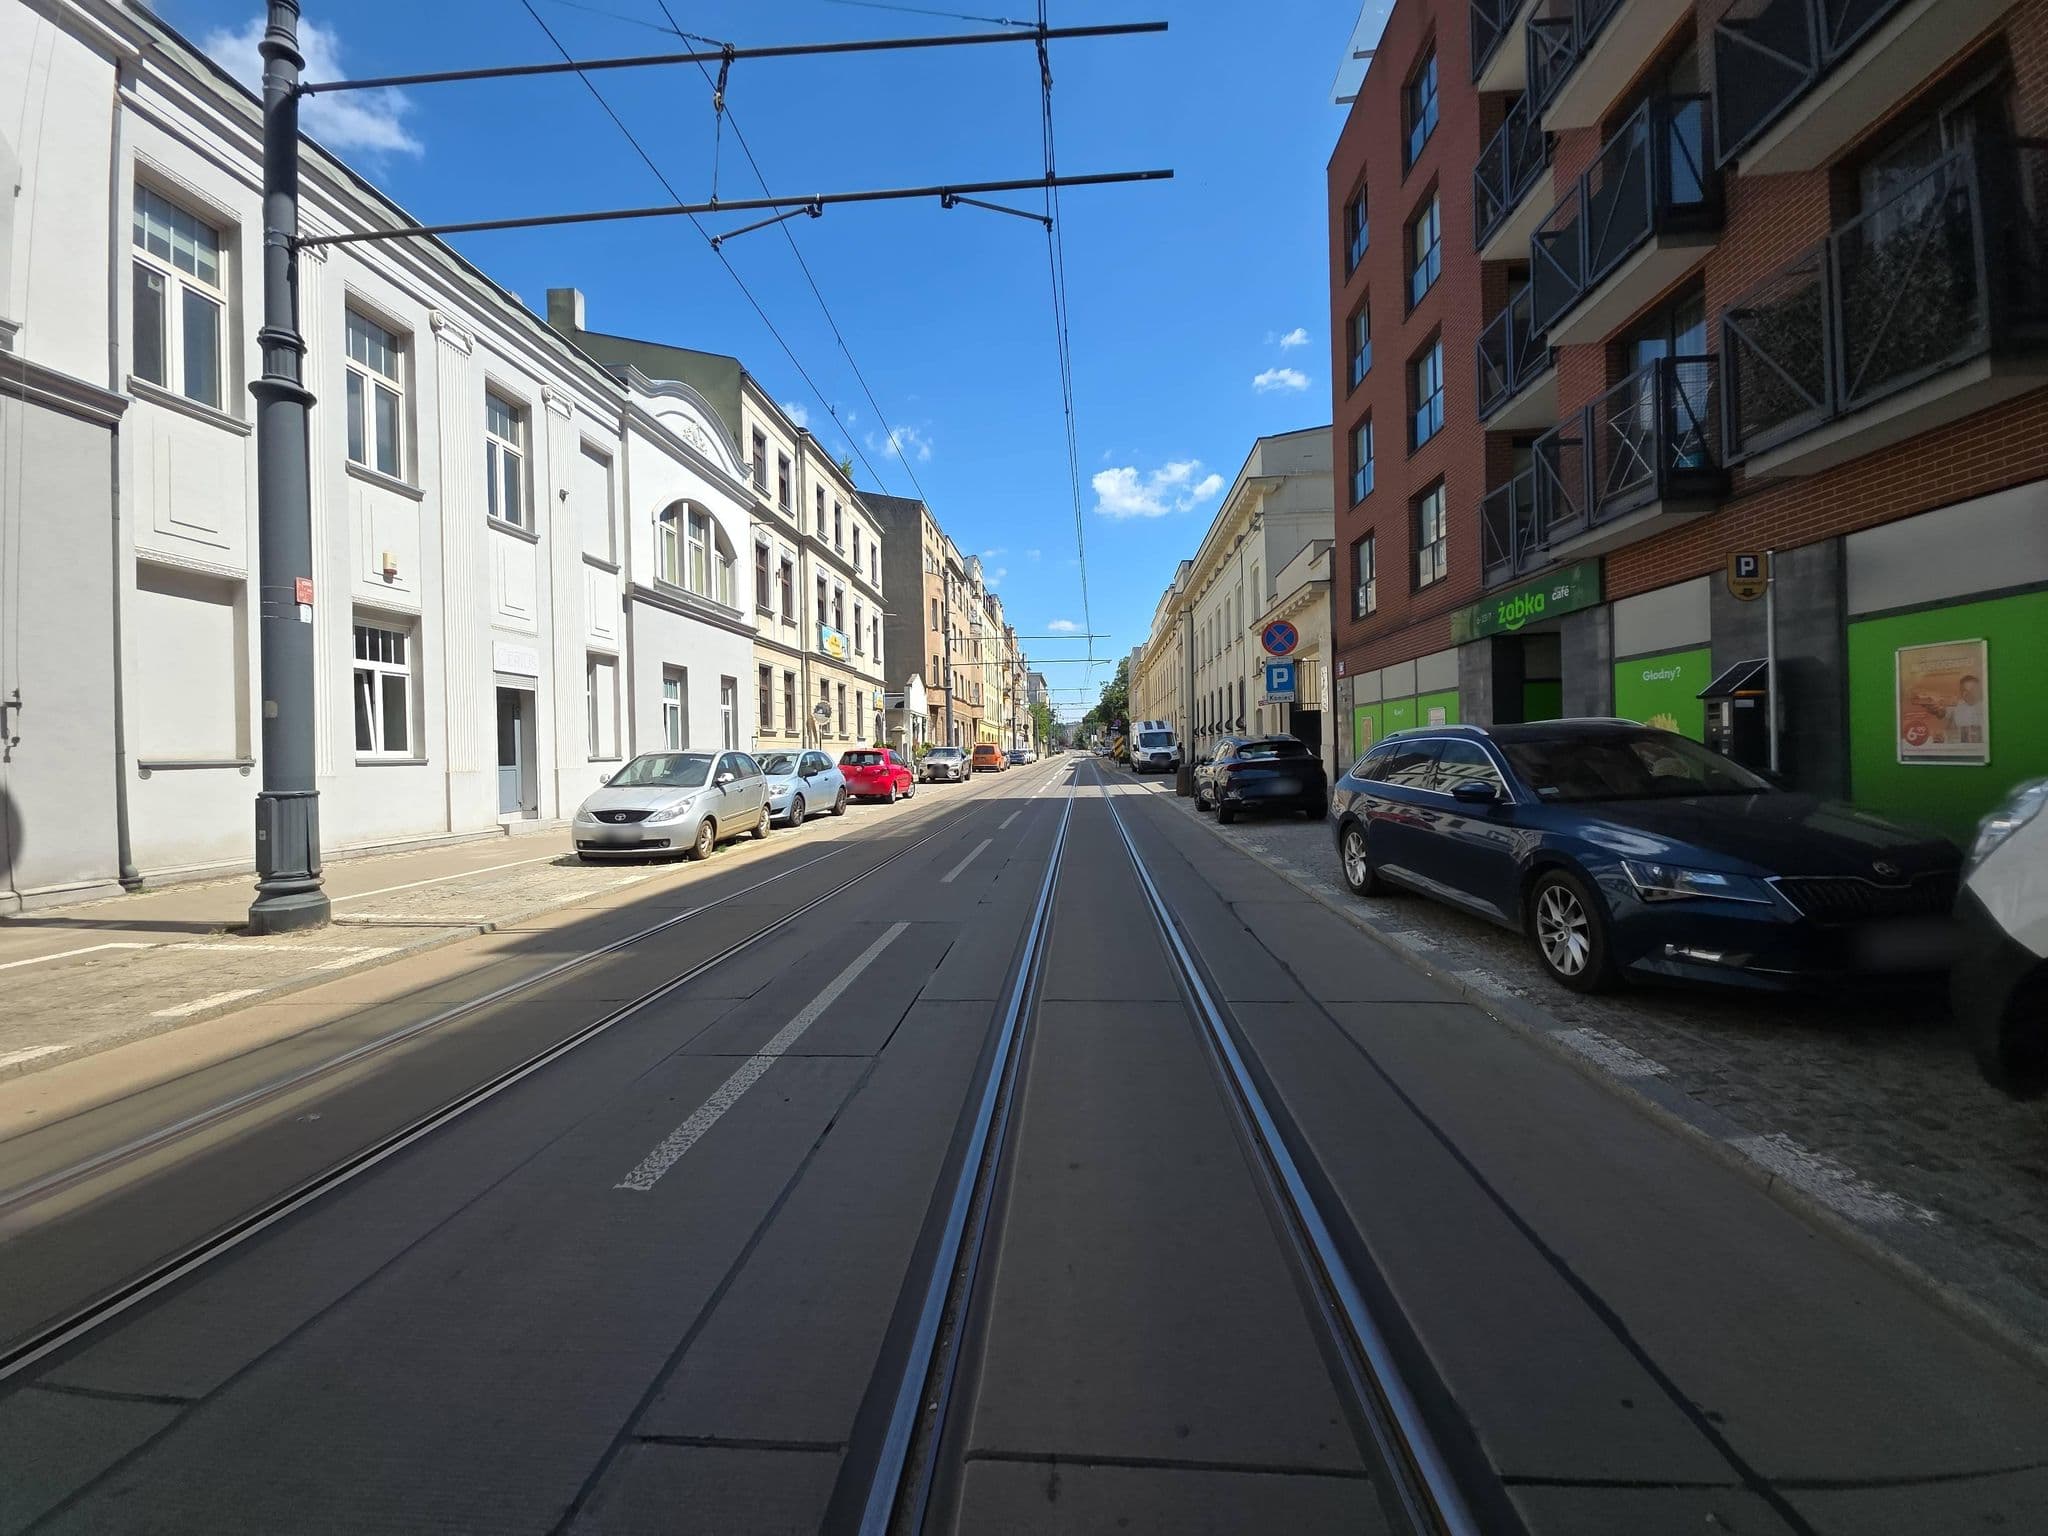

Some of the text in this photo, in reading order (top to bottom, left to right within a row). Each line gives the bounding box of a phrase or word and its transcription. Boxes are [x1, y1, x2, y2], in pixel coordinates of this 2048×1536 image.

[1740, 557, 1754, 576] P
[1498, 592, 1545, 624] żabka
[1272, 667, 1289, 689] P
